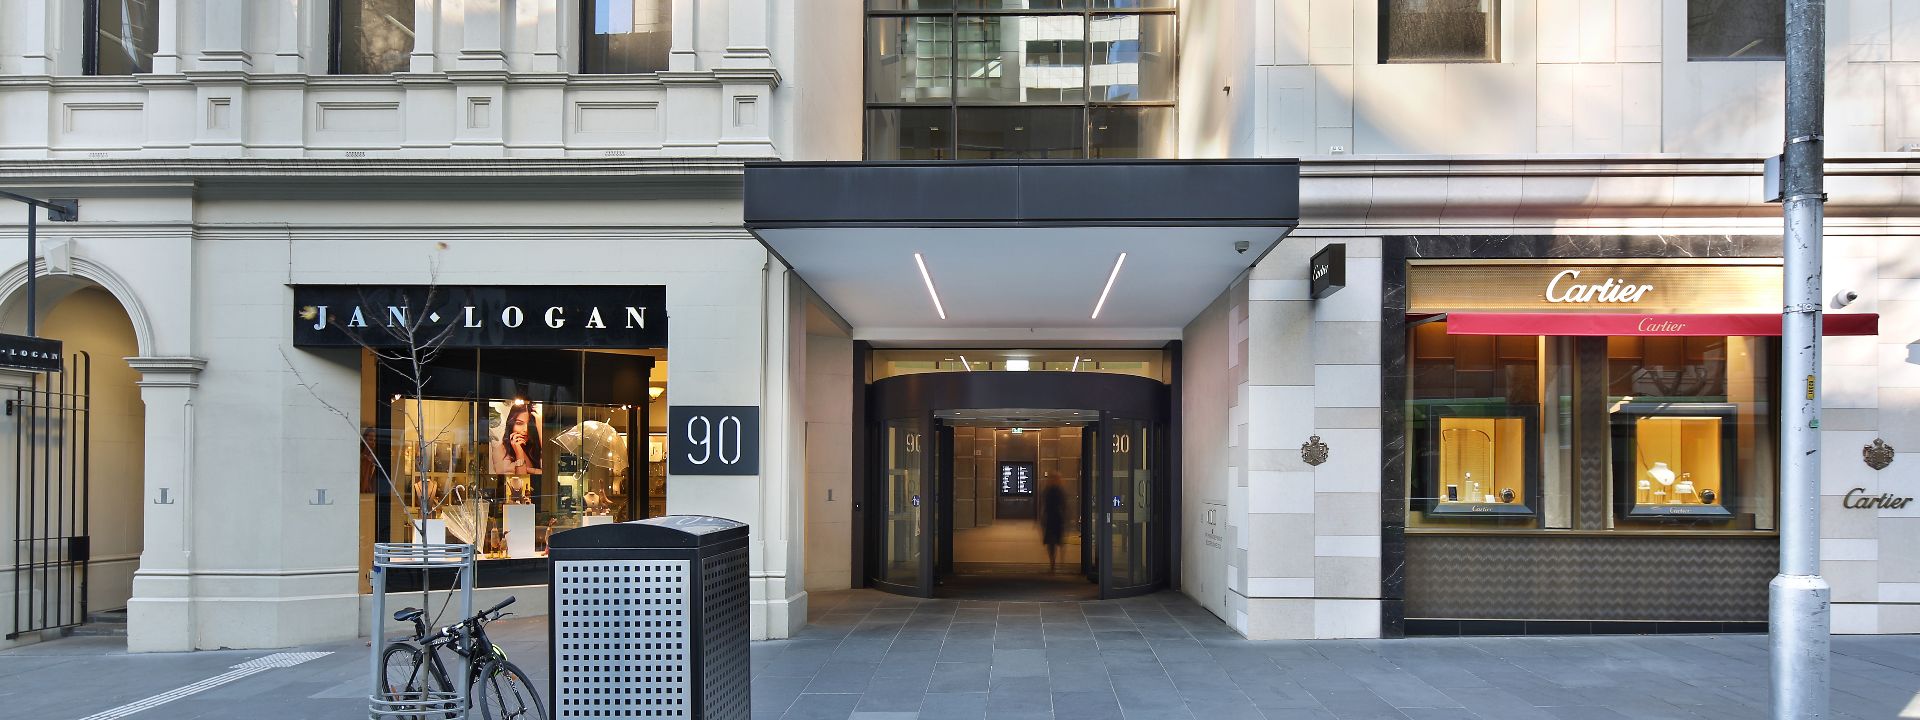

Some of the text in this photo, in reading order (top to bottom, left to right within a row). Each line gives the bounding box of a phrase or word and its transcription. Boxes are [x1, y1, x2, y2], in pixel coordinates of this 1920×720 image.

[1545, 269, 1654, 303] Cartier
[313, 305, 647, 330] JAN LOGAN
[1638, 317, 1686, 332] Cartier
[9, 348, 59, 360] LOGAN
[687, 415, 741, 465] 90
[1843, 487, 1914, 510] Cartier
